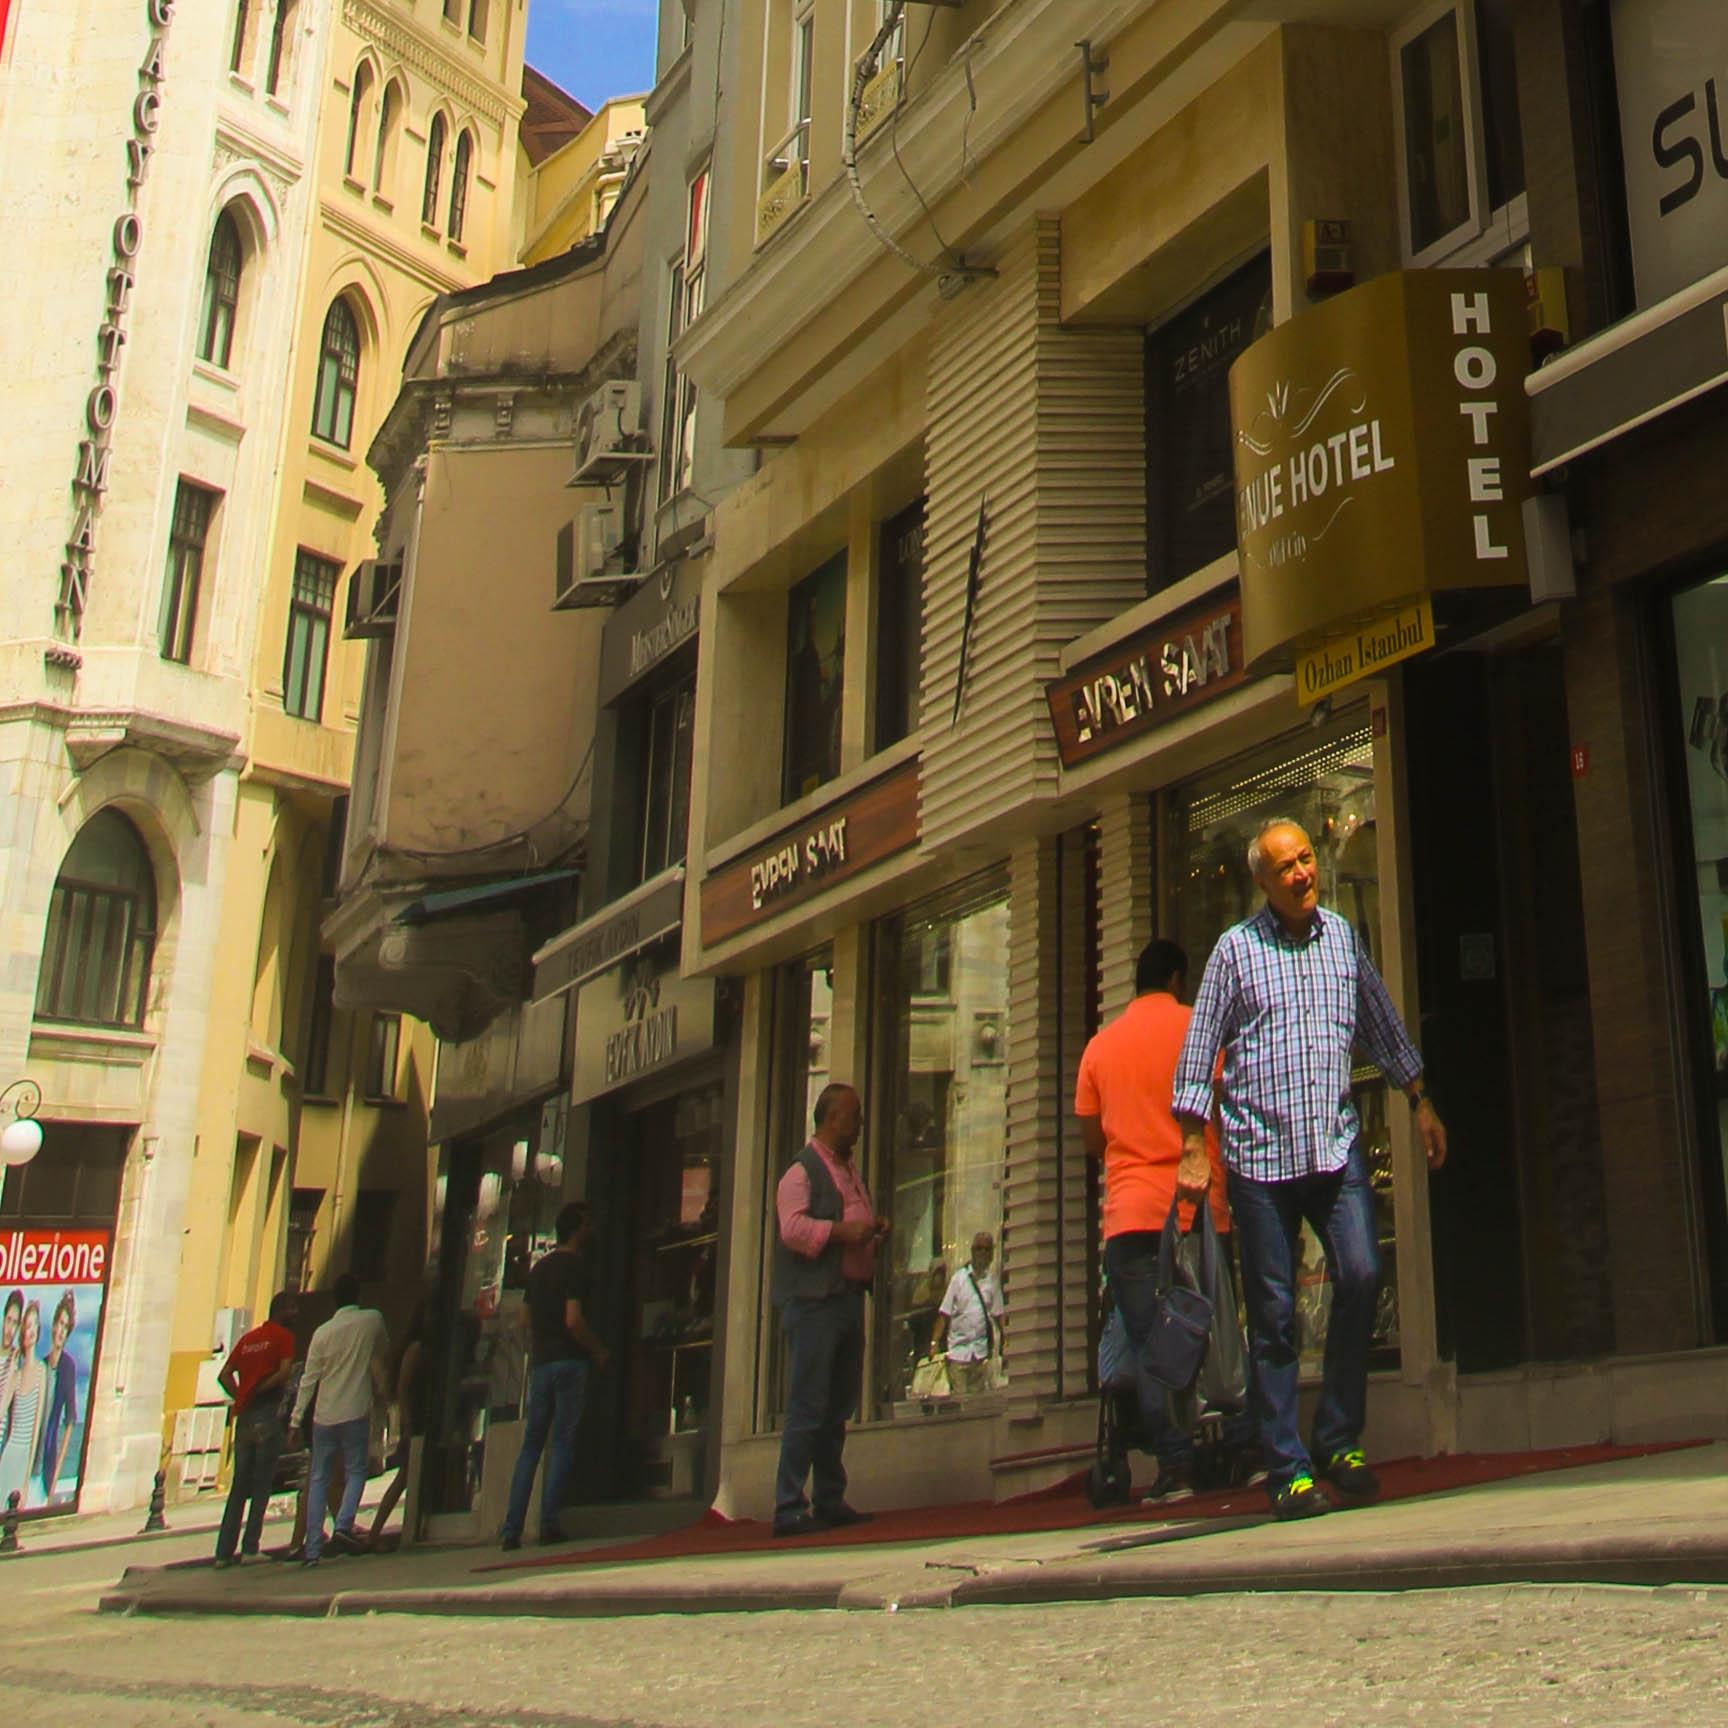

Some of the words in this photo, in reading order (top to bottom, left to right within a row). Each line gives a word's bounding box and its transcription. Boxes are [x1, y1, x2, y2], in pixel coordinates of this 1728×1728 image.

[1174, 318, 1241, 382] ZENITH
[54, 212, 143, 619] OTTOMAN
[1289, 419, 1396, 508] HOTEL
[1450, 291, 1509, 560] HOTEL
[1075, 656, 1154, 745] EVREN
[1161, 613, 1233, 697] SAAT
[1305, 648, 1354, 694] Ozhan
[751, 842, 799, 912] EVREN
[805, 815, 846, 876] SAAT
